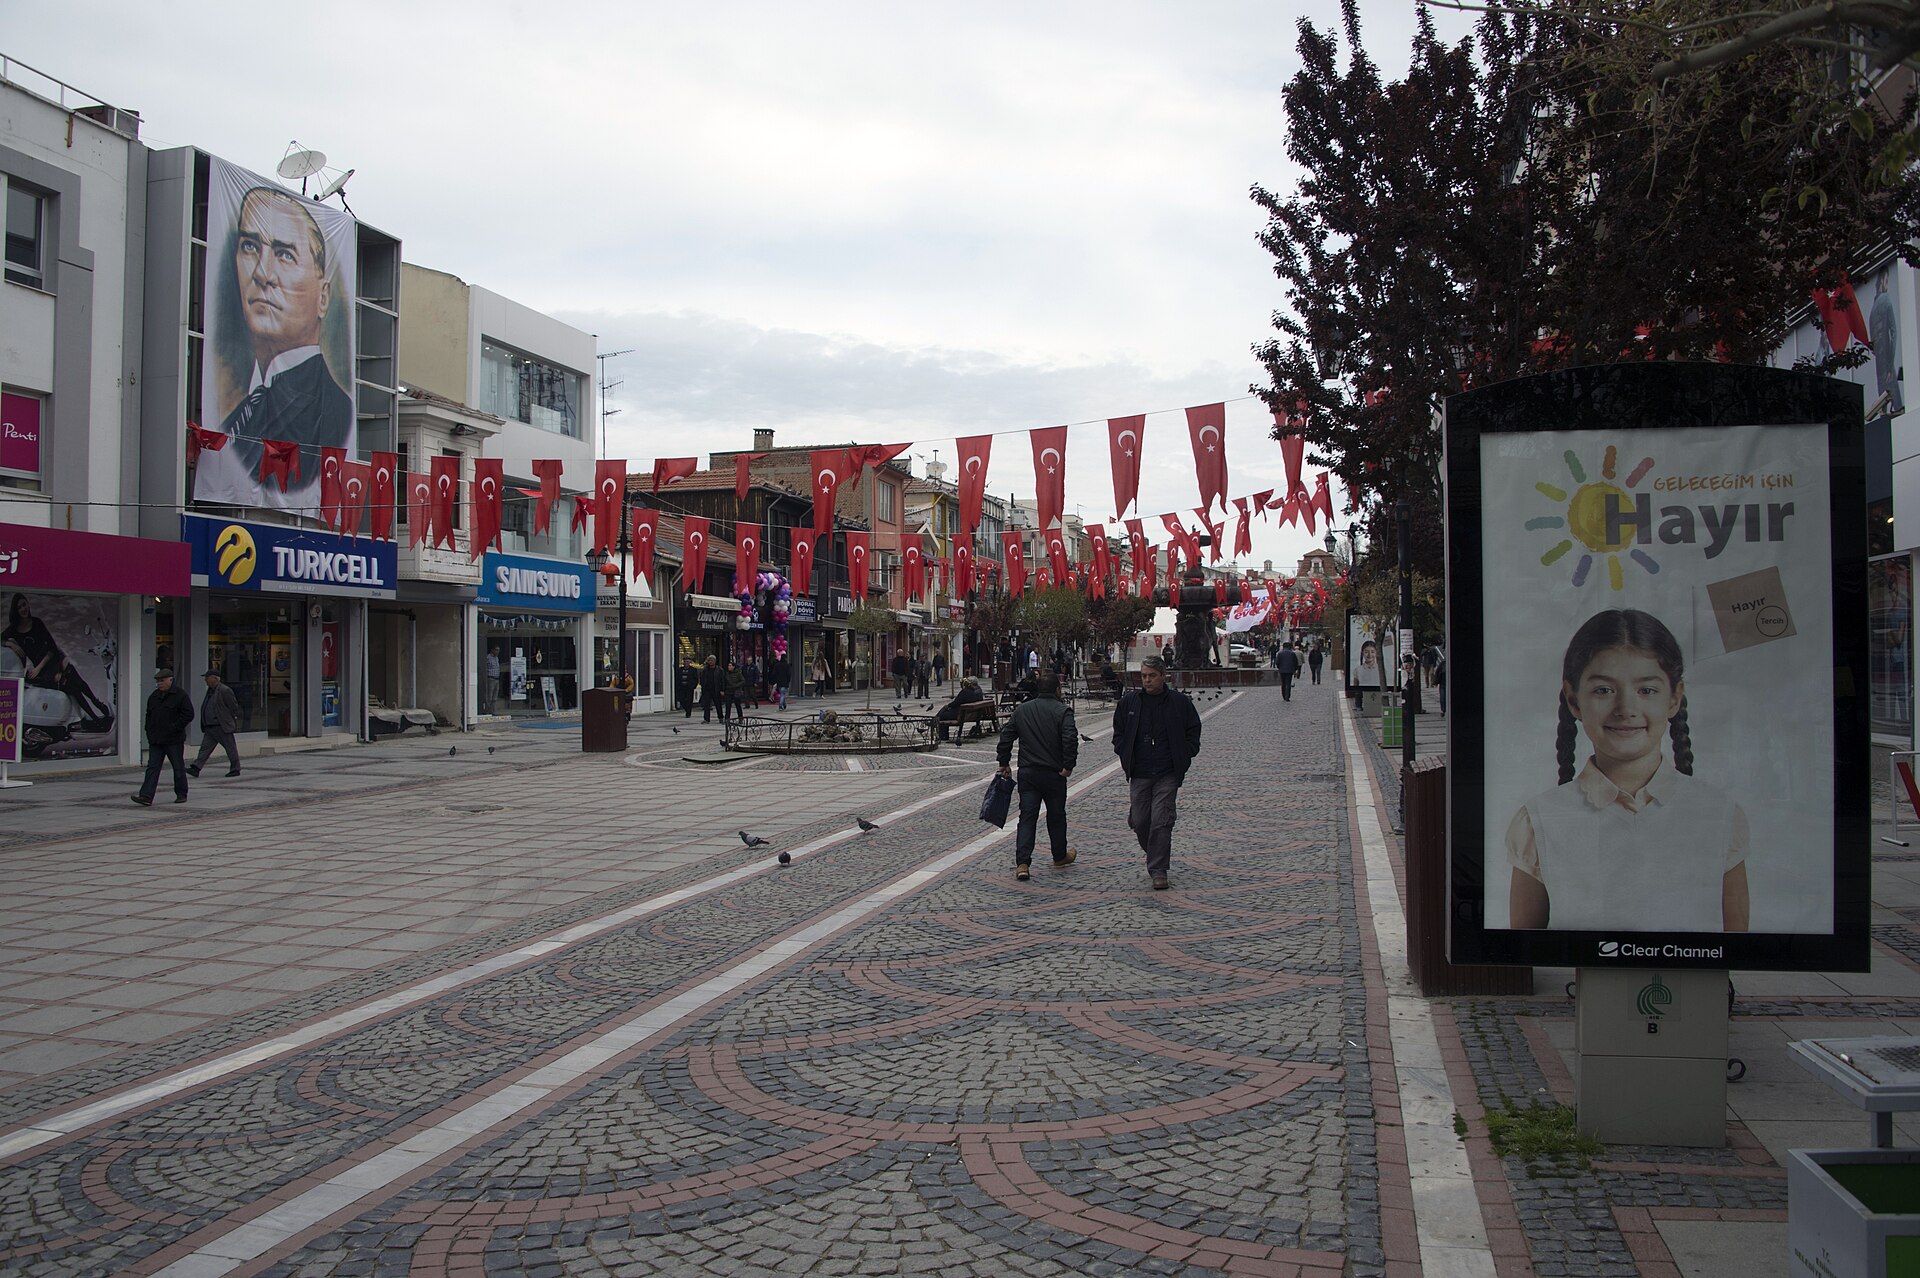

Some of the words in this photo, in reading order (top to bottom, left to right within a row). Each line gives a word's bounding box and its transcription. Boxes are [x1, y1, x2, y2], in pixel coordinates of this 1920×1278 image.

[3, 422, 37, 441] Penti
[1653, 473, 1754, 491] GELECEĞİM
[1605, 493, 1795, 560] Hayır
[273, 546, 384, 586] TURKCELL
[496, 566, 581, 599] SAMSUNG
[1731, 597, 1766, 613] Hayır
[1760, 617, 1784, 625] Tercih
[1621, 943, 1660, 957] Clear
[1662, 944, 1723, 959] Channel
[1647, 1022, 1658, 1034] B
